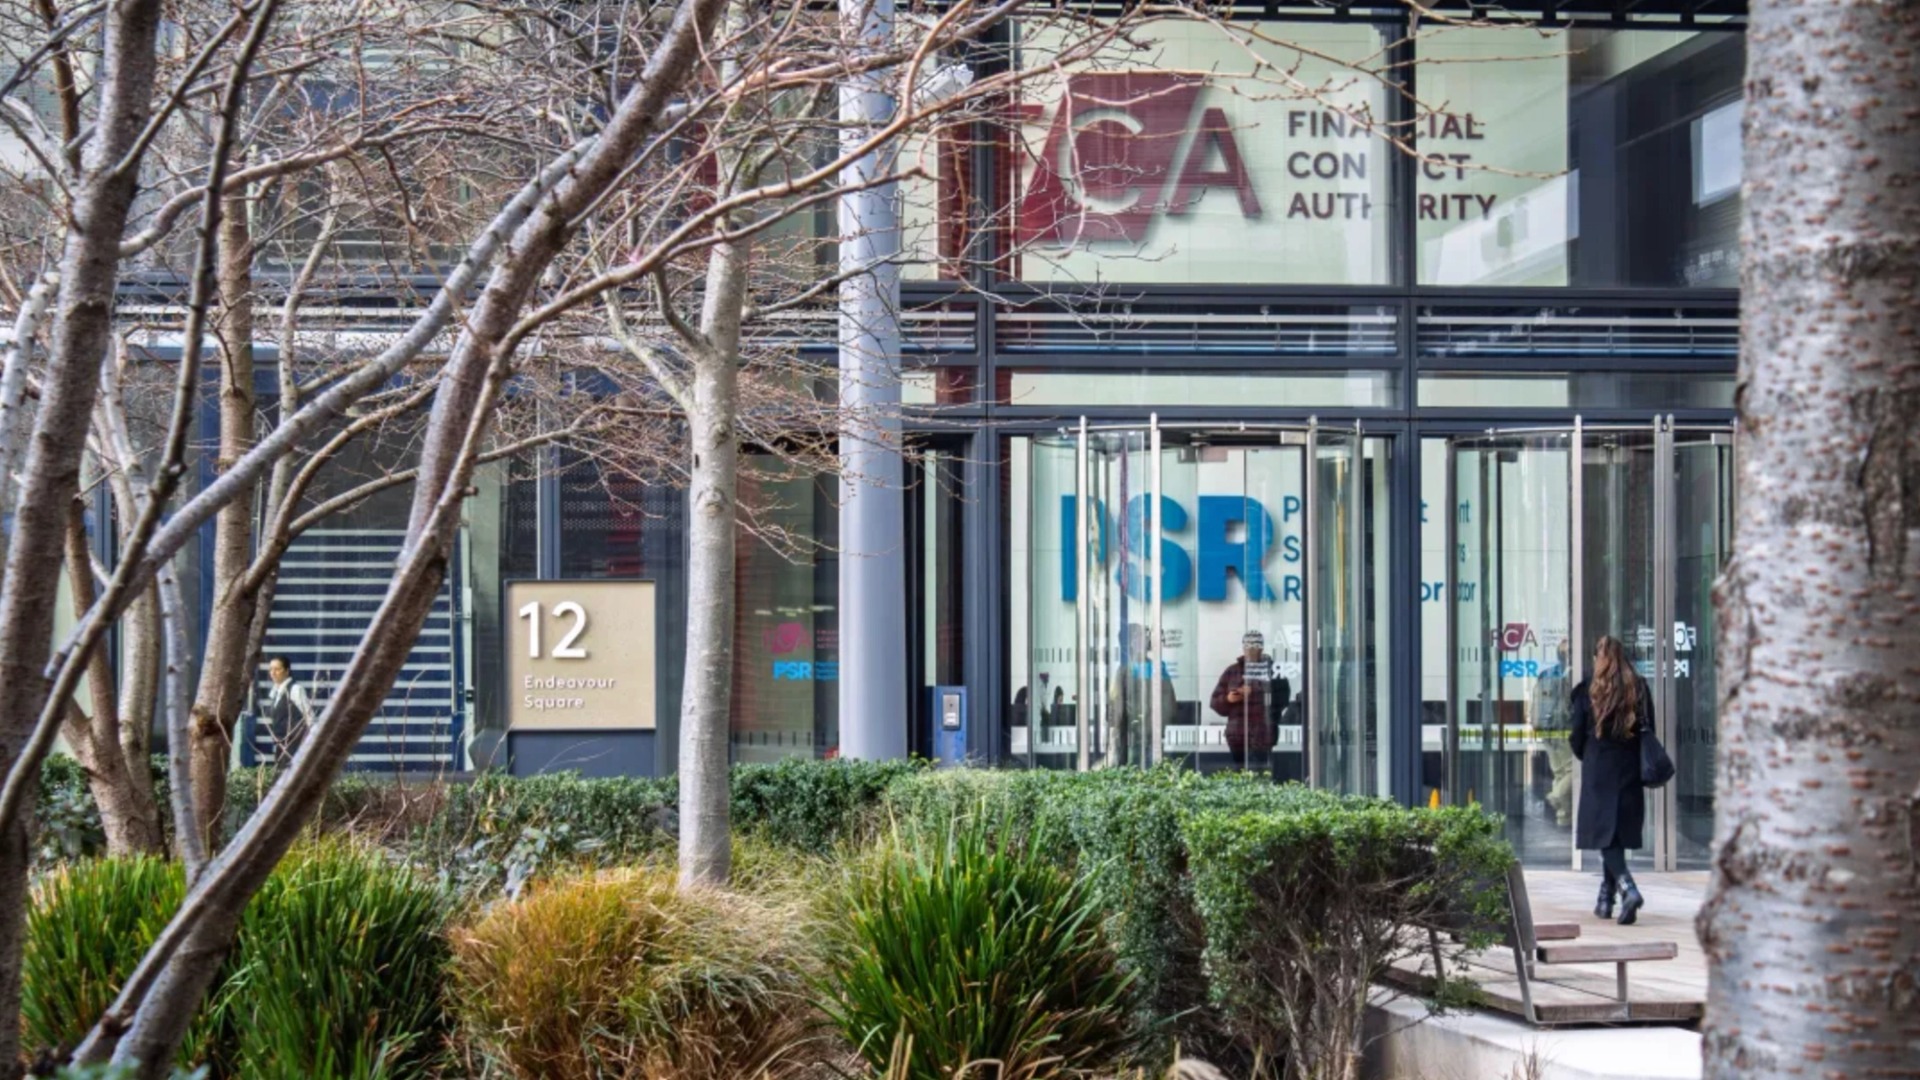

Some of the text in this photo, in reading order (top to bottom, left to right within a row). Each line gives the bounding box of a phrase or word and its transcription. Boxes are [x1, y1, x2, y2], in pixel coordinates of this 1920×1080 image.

[1288, 151, 1471, 180] CONCT
[519, 600, 587, 659] 12
[773, 660, 812, 680] PSR
[1499, 660, 1539, 678] PSR
[524, 674, 616, 690] Endeavour
[524, 694, 584, 711] Square
